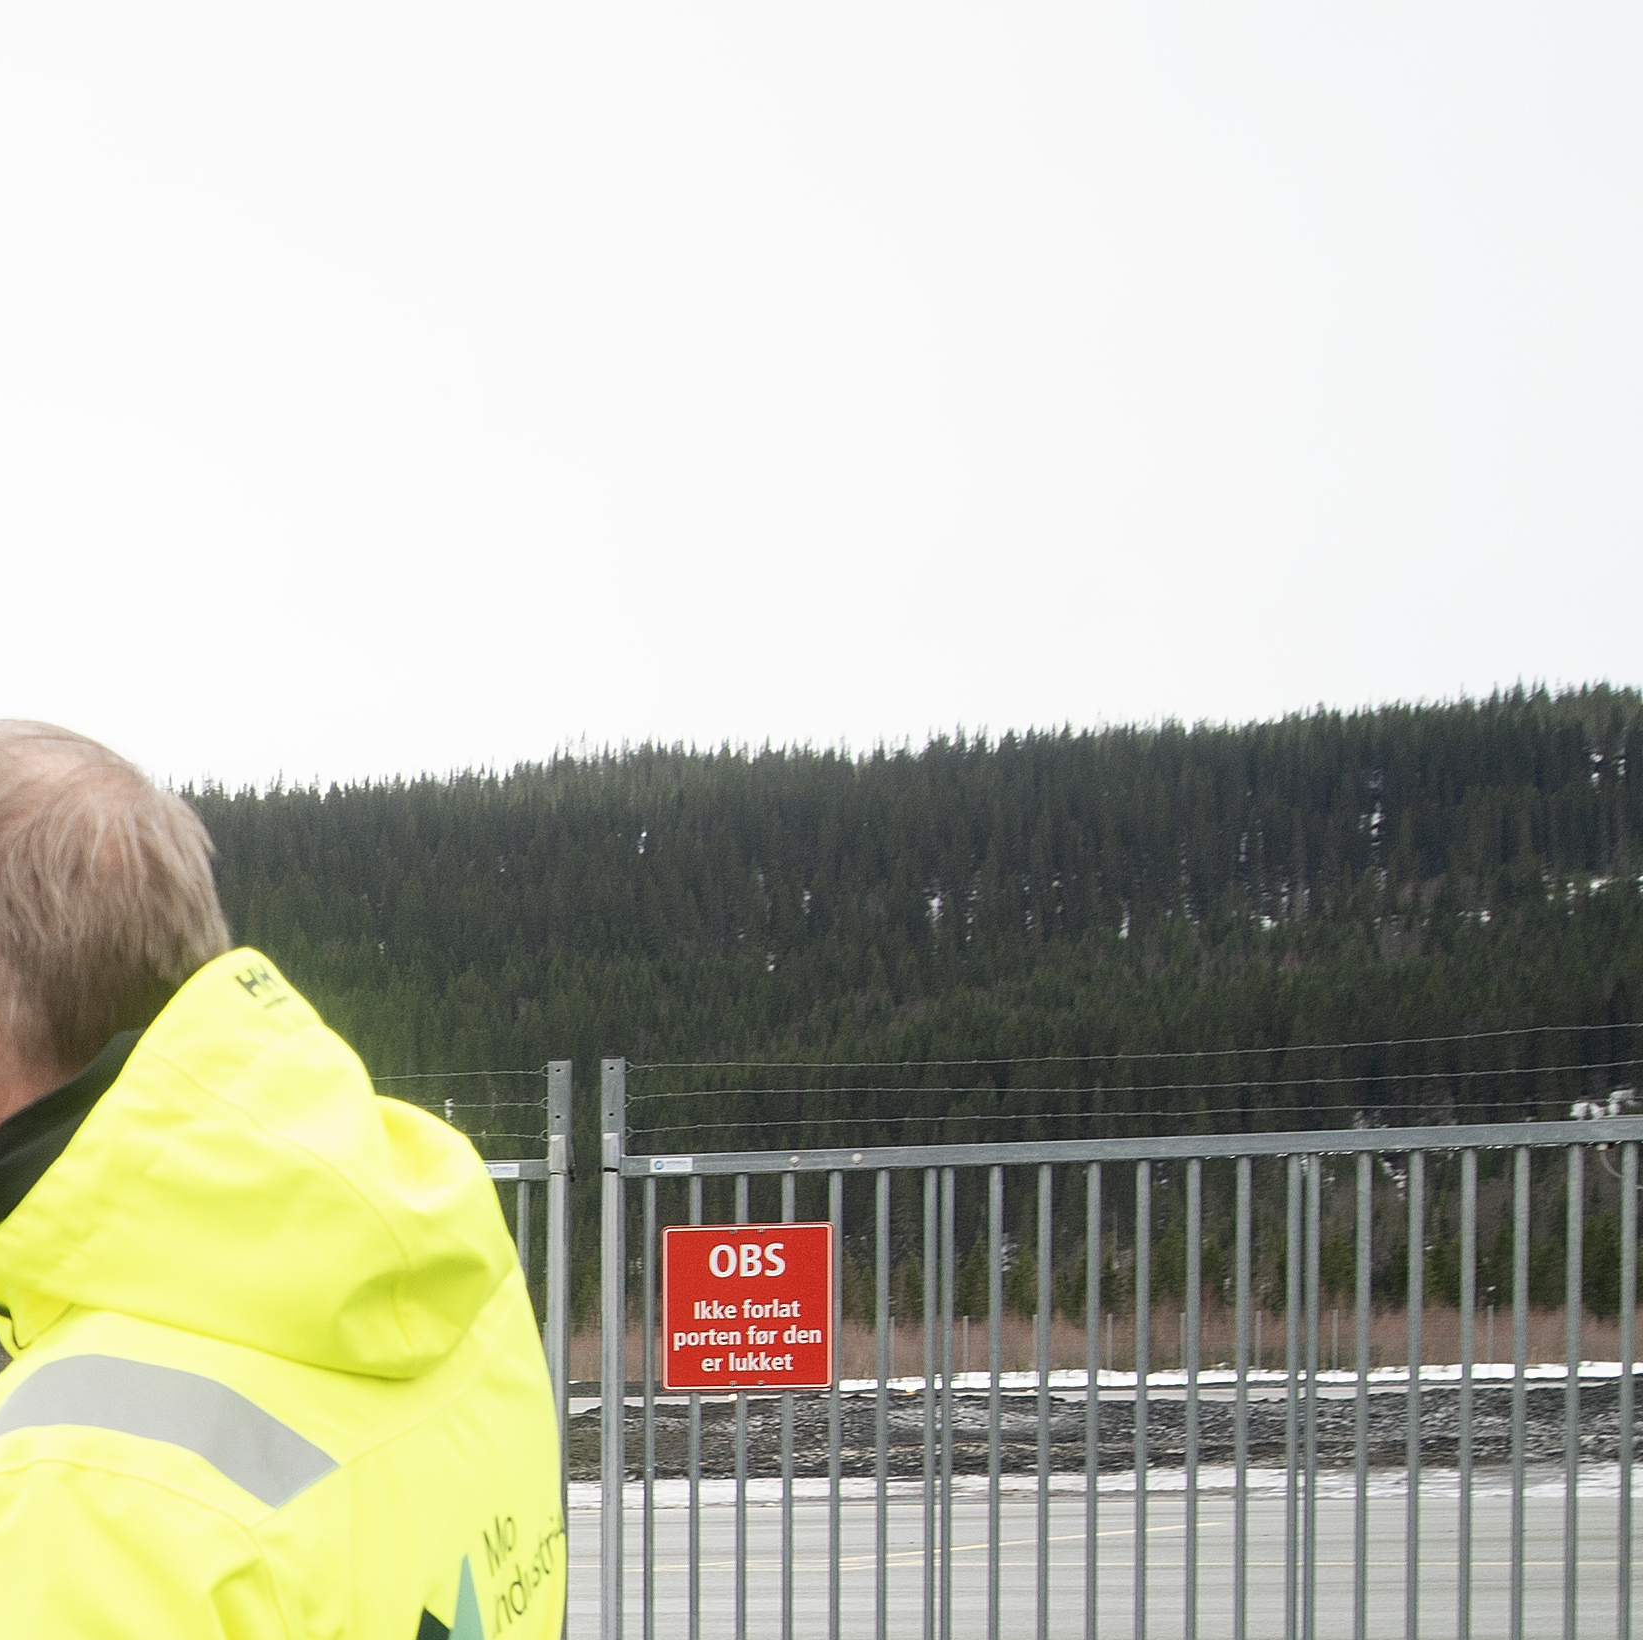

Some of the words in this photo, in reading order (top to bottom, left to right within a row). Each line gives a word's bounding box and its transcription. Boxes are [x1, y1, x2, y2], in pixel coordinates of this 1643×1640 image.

[708, 1243, 786, 1278] OBS
[693, 1300, 737, 1320] Ikke
[742, 1298, 801, 1319] forlat
[673, 1328, 741, 1351] porten
[746, 1325, 778, 1346] før
[783, 1324, 822, 1344] den
[701, 1356, 723, 1372] er
[728, 1352, 794, 1372] lukket
[483, 1516, 517, 1577] Mo
